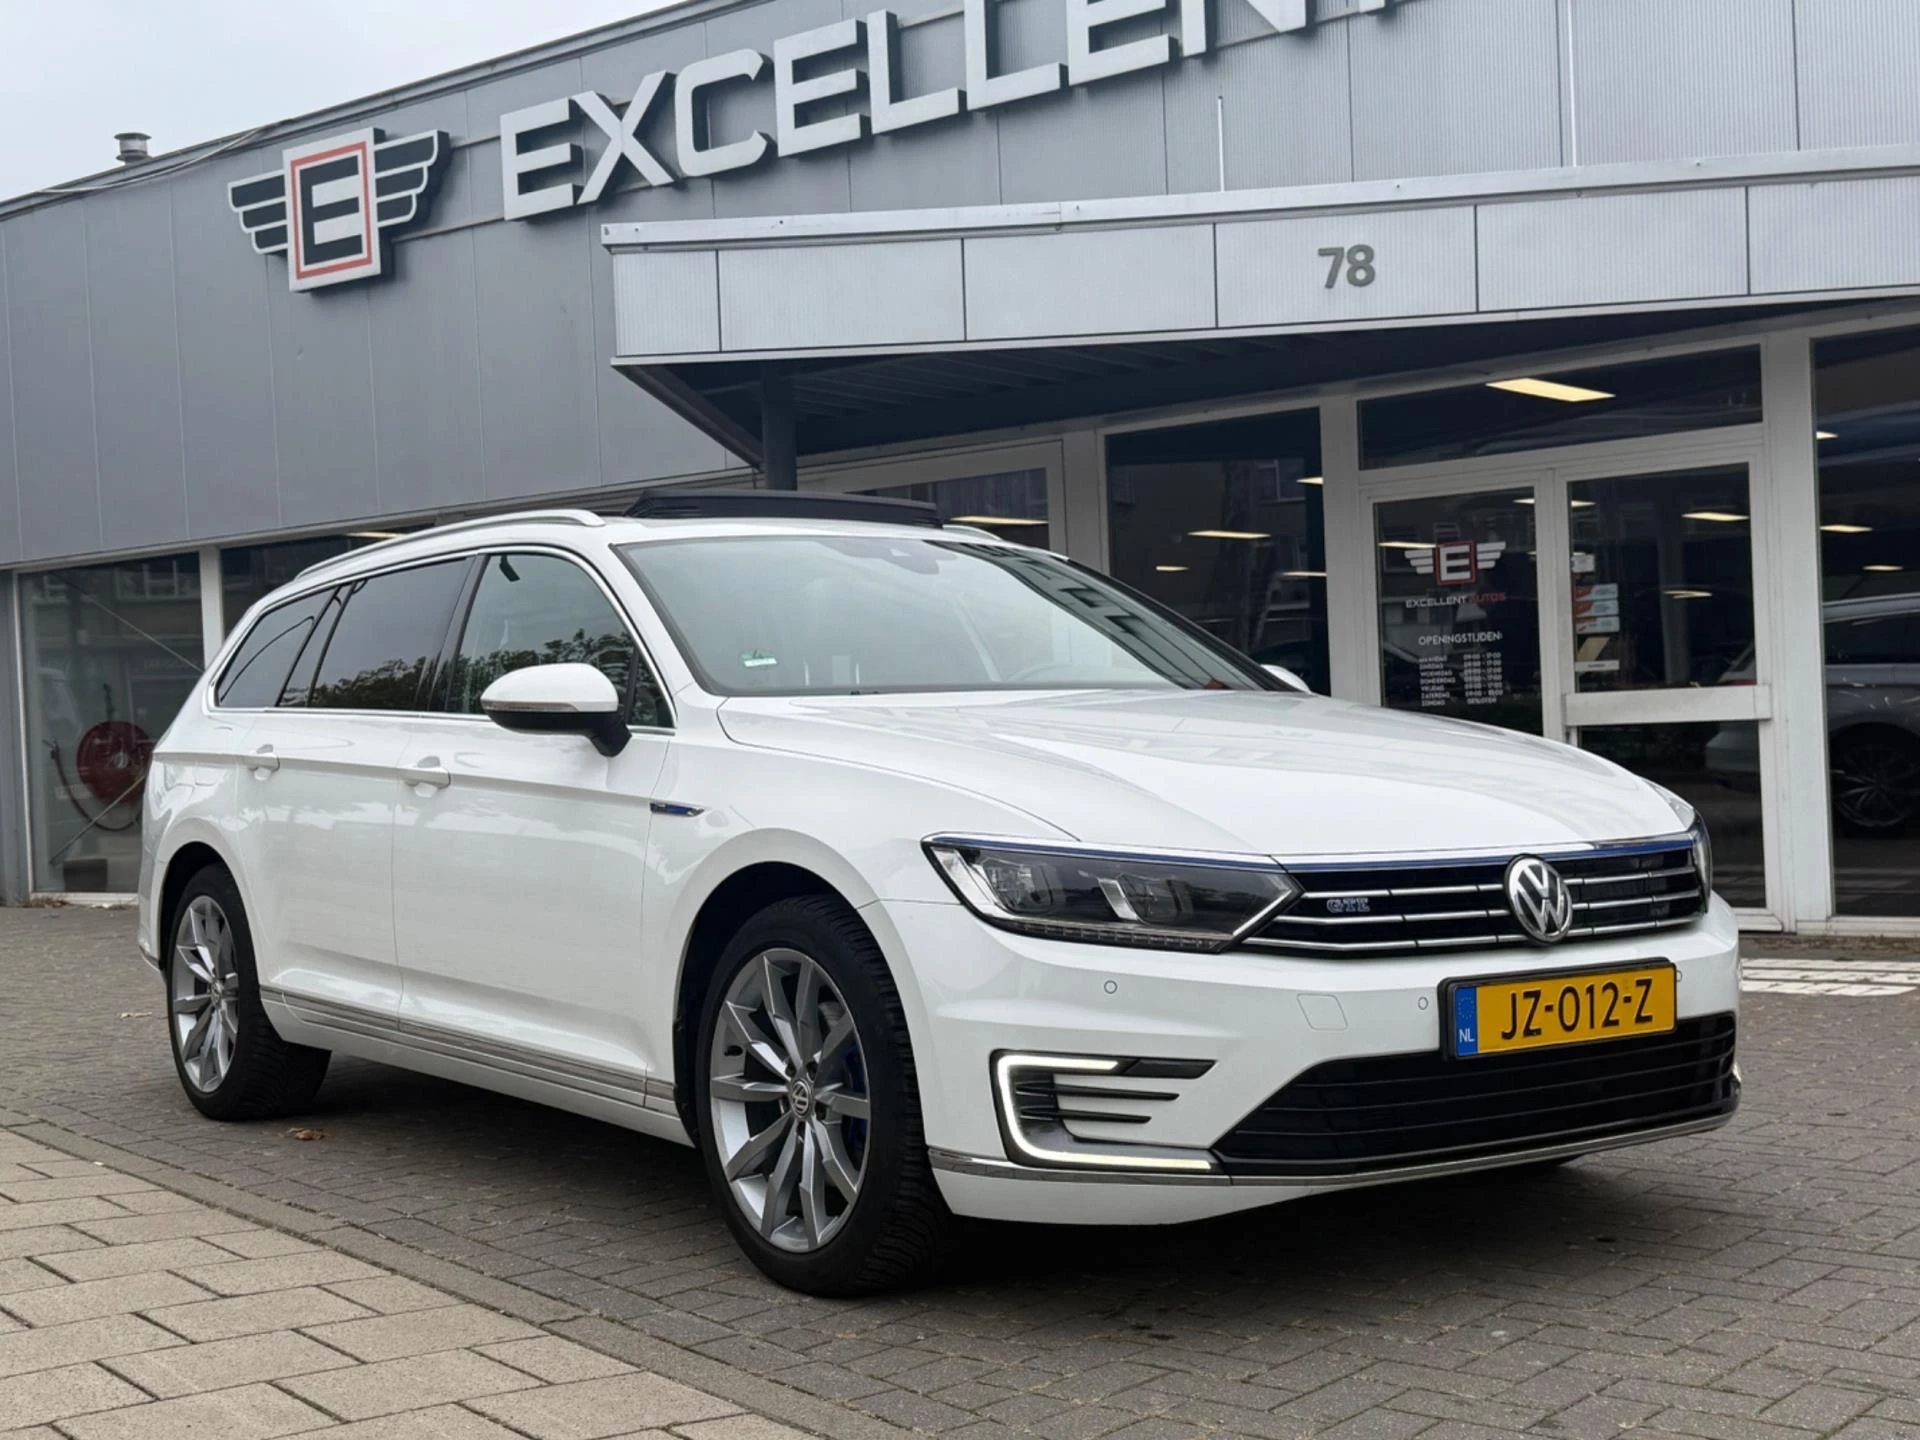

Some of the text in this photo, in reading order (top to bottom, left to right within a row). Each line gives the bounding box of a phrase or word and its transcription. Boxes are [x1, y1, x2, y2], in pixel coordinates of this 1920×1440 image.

[500, 0, 1385, 220] EXCELLE
[1317, 244, 1376, 289] 78
[1405, 595, 1467, 608] EXCELLENT
[1326, 897, 1370, 913] GTE
[1501, 978, 1653, 1040] JZ-012-Z
[1458, 1028, 1475, 1042] NL
